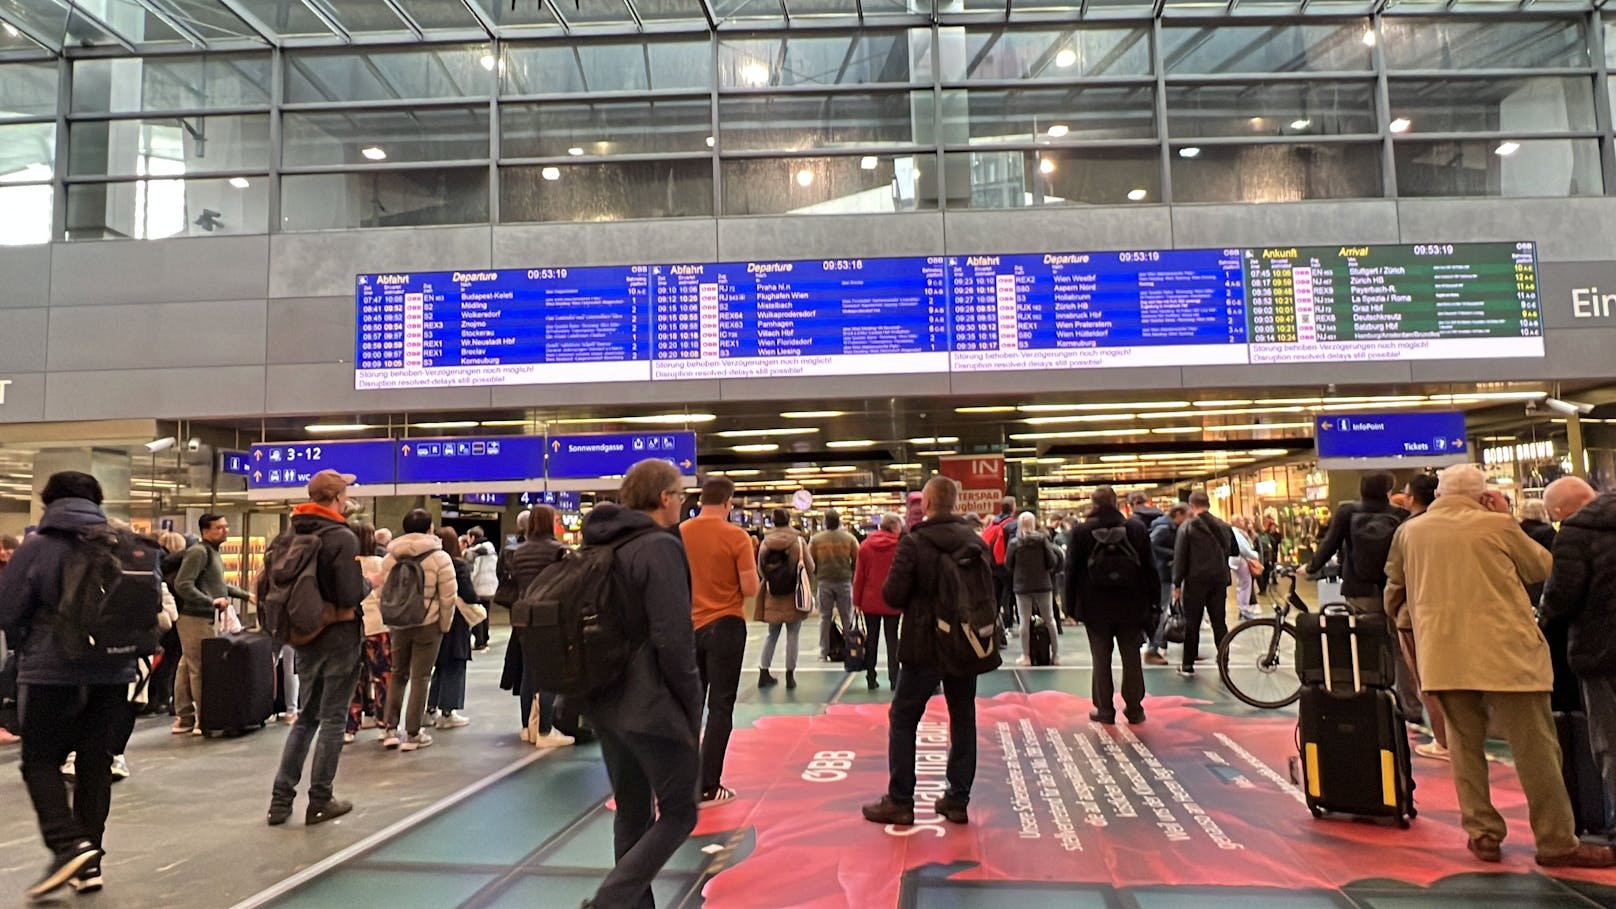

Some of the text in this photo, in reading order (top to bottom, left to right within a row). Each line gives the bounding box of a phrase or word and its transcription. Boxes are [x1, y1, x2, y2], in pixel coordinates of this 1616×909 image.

[1263, 249, 1298, 258] Ankunft
[1339, 247, 1368, 256] Arrival
[1414, 245, 1453, 255] 09:53:19
[966, 257, 1000, 266] Abfahrt
[1044, 254, 1089, 264] Departure
[1119, 252, 1159, 262] 09:53:19
[670, 265, 703, 274] Abfahrt
[747, 263, 792, 273] Departure
[1384, 266, 1405, 275] Zürich
[452, 272, 497, 282] Departure
[527, 269, 567, 279] 09:53:19
[376, 275, 409, 284] Abfahrt
[1373, 276, 1384, 284] HB
[757, 292, 790, 301] Flughafen
[1362, 296, 1385, 304] Spezia
[461, 302, 487, 310] Mödling
[758, 320, 793, 328] Pamhagen
[1354, 323, 1384, 331] Salzburg
[758, 329, 780, 337] Villach
[503, 337, 515, 345] Hbf
[758, 339, 775, 347] Wien
[777, 337, 812, 346] Floridsdorf
[777, 347, 801, 355] Liesing
[461, 357, 500, 365] Korneuburg
[359, 370, 388, 378] Störung
[656, 371, 692, 379] Disruption
[756, 367, 768, 375] still
[1353, 423, 1385, 431] InfoPoint
[568, 442, 624, 453] Sonnwendgasse
[1404, 442, 1429, 451] Tickets
[972, 460, 998, 474] IN
[297, 473, 311, 482] WC
[520, 491, 530, 503] 4
[1163, 780, 1195, 803] Herzen
[1152, 807, 1176, 822] uns
[1156, 821, 1190, 841] Weil
[1193, 814, 1244, 850] genauso
